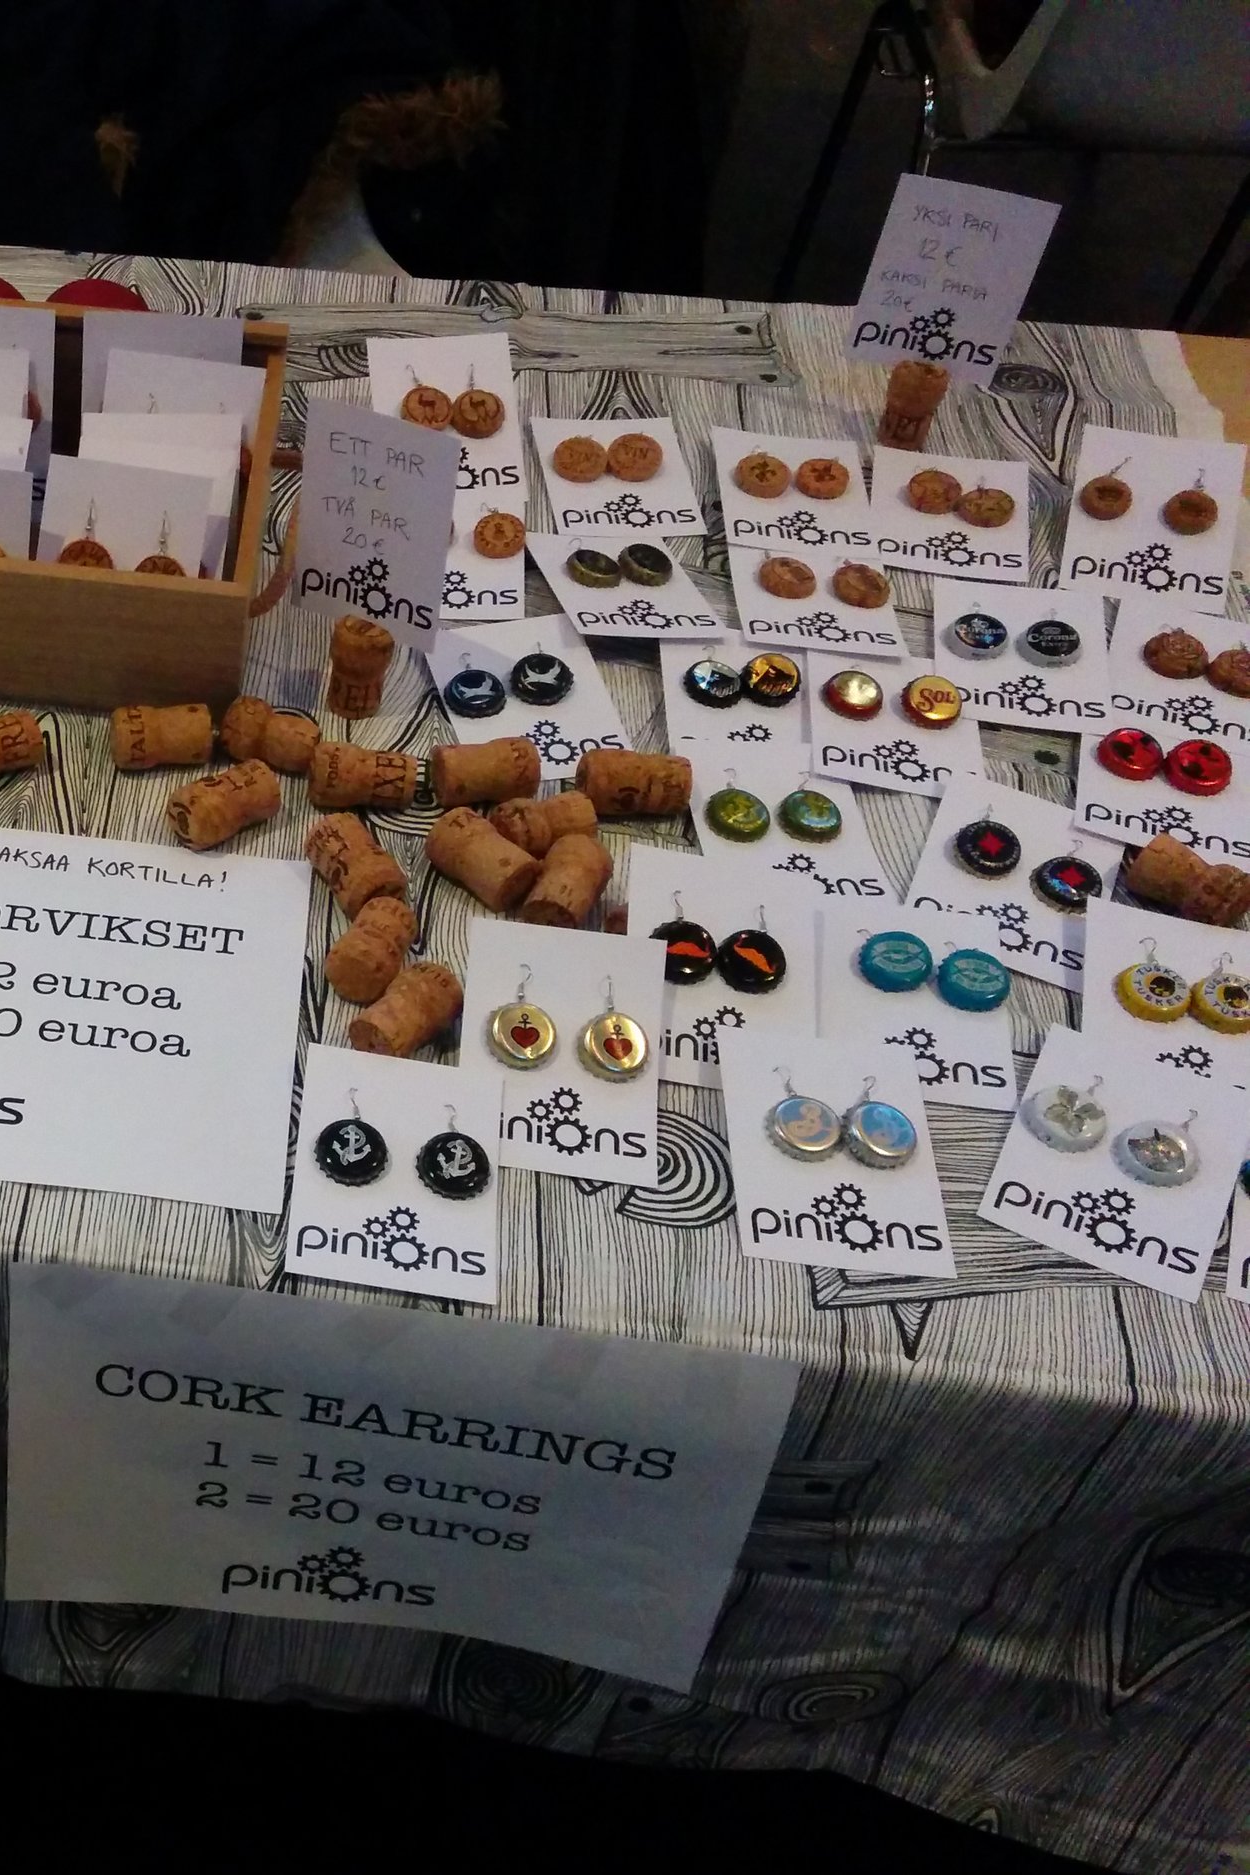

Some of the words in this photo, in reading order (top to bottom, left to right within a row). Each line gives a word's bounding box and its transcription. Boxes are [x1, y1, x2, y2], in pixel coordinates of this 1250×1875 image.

[853, 317, 997, 366] pinions
[330, 432, 371, 455] ETT
[386, 448, 425, 477] PAR
[370, 509, 410, 541] PAR
[563, 501, 697, 528] pinions
[733, 514, 872, 546] pinions
[877, 535, 1022, 568] pinions
[1071, 550, 1224, 595] pinions
[301, 567, 434, 630] pinions
[576, 605, 716, 630] pinions
[749, 616, 897, 646] pinions
[1111, 693, 1250, 740] pinion
[822, 745, 953, 782] pinion
[87, 858, 229, 892] KORTILLA!
[31, 973, 181, 1011] euroa
[38, 1019, 191, 1058] euroa
[499, 1100, 647, 1158] inions
[296, 1220, 487, 1277] pinions
[751, 1199, 943, 1254] pinions
[994, 1180, 1200, 1276] pinions
[95, 1364, 284, 1418] CORK
[299, 1392, 677, 1480] EARRINGS
[203, 1441, 230, 1468] 1
[250, 1453, 279, 1467] =
[298, 1453, 366, 1487] 12
[383, 1472, 542, 1515] euros
[195, 1481, 229, 1509] 2
[244, 1492, 274, 1506] =
[288, 1492, 360, 1526] 20
[375, 1511, 531, 1553] euros
[222, 1555, 437, 1606] pinions
